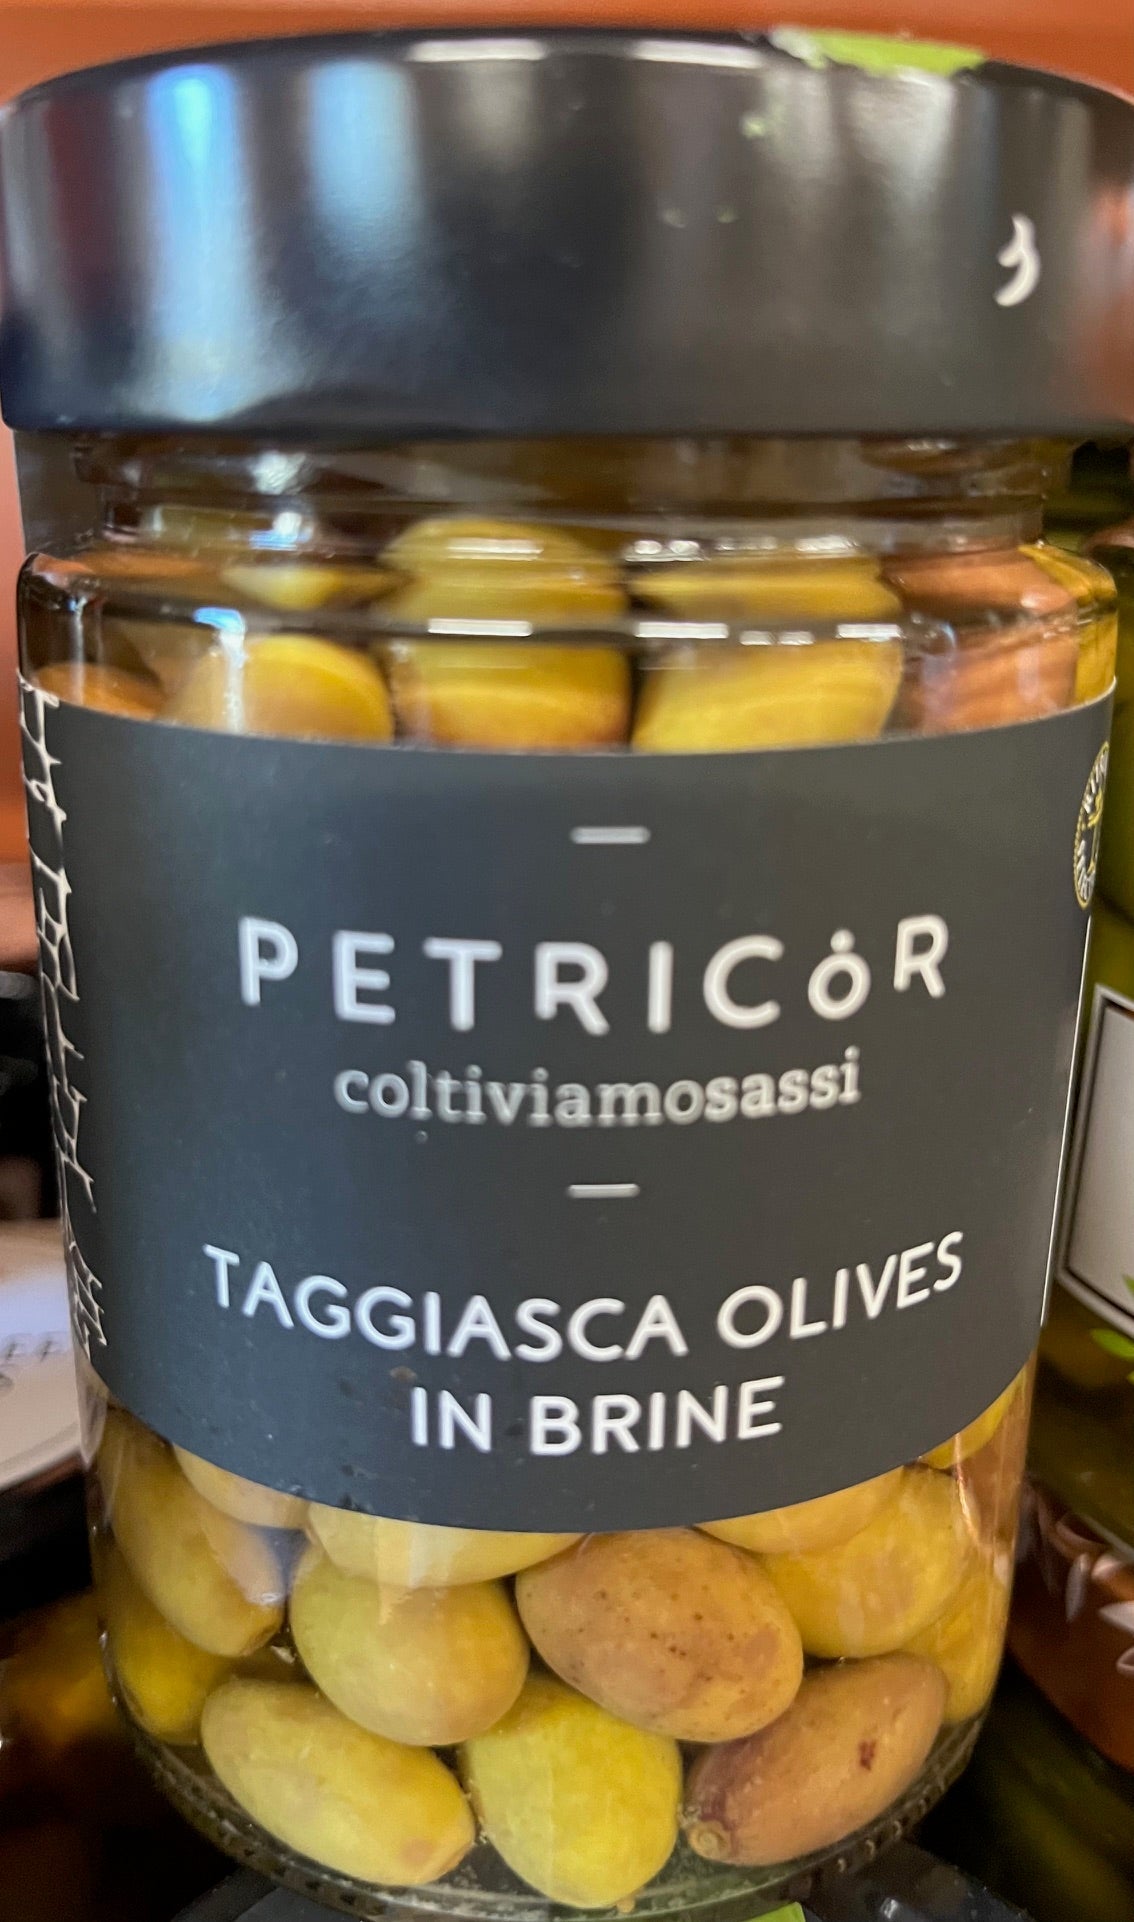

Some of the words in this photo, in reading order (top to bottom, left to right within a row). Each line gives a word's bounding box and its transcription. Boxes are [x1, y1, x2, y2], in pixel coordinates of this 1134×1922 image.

[335, 1046, 861, 1127] coltiviamosassi
[203, 1244, 689, 1363] TAGGIASCA
[716, 1231, 965, 1349] OLIVES
[410, 1386, 493, 1453] IN
[529, 1375, 785, 1456] BRINE
